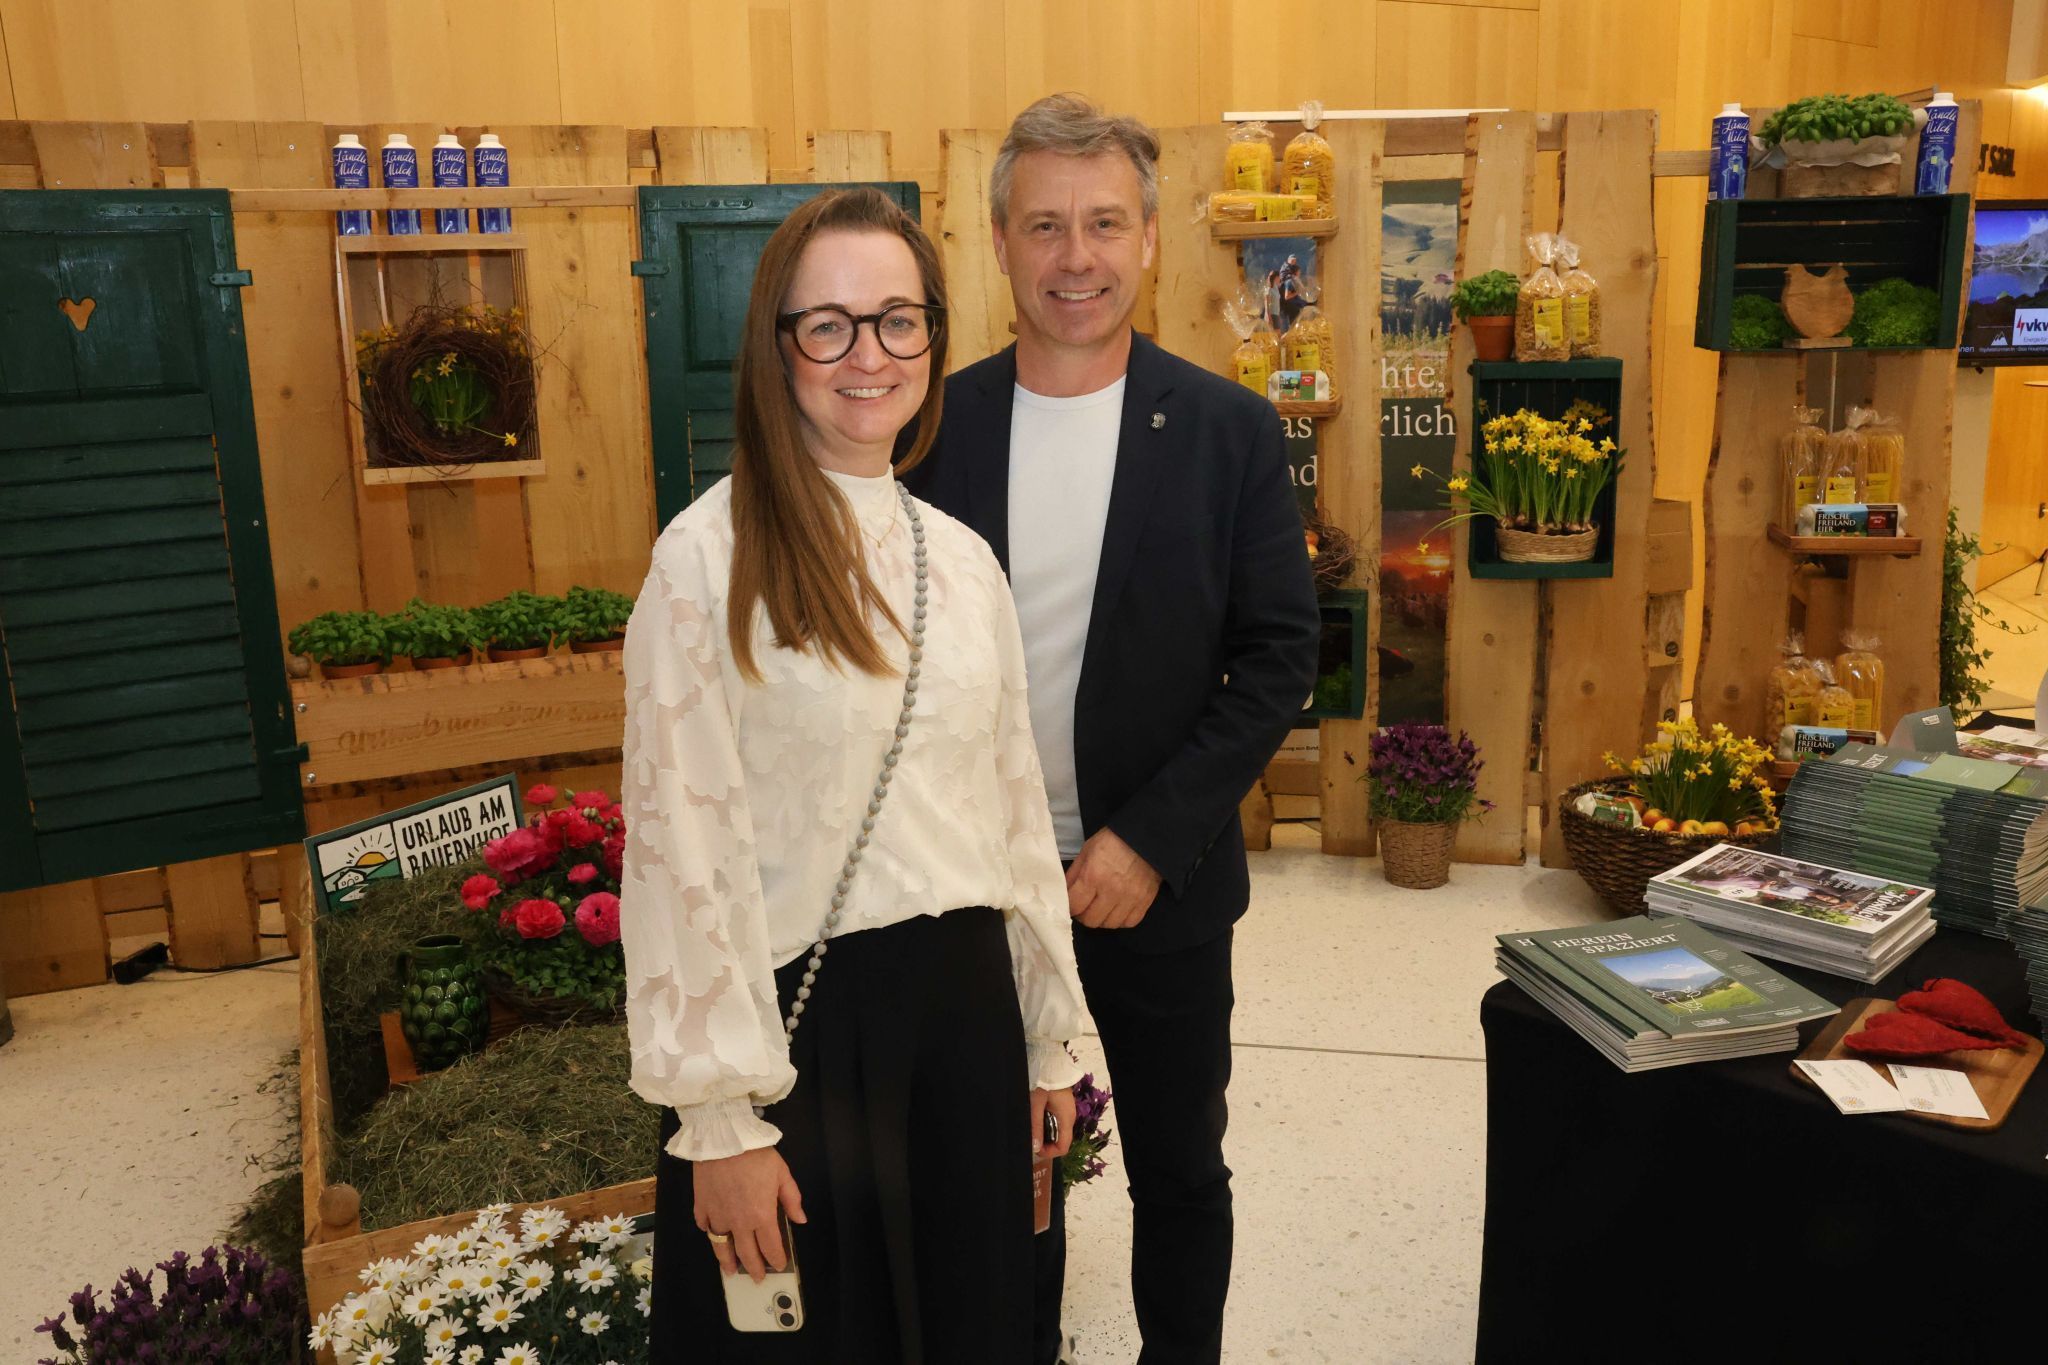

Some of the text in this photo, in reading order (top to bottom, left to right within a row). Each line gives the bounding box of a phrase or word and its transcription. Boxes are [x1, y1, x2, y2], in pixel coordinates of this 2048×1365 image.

[401, 795, 506, 850] URLAUB AM
[1552, 932, 1634, 949] HEREIN
[1580, 933, 1679, 954] SPAZIERT
